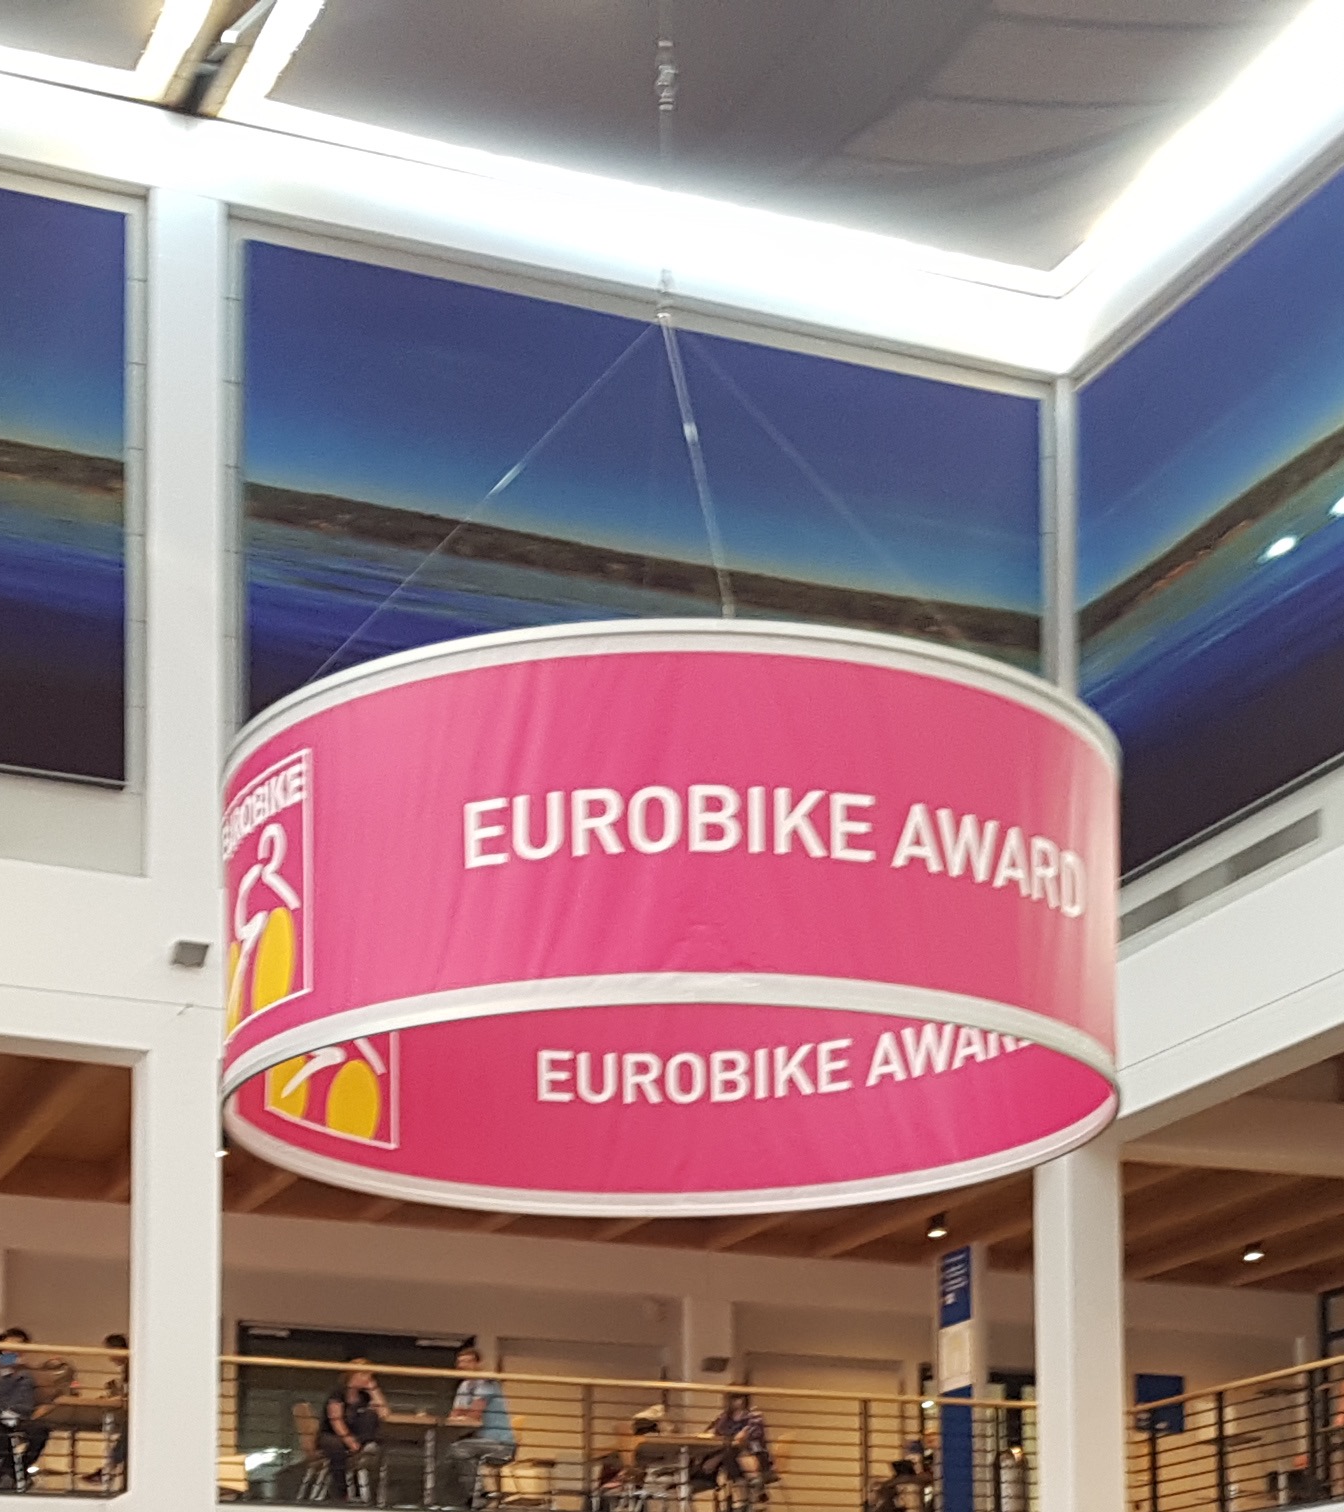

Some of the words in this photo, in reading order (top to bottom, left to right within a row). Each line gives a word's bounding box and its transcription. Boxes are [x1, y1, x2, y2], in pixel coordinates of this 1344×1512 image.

[463, 783, 876, 869] EUROBIKE
[892, 803, 1087, 918] AWARD
[536, 1038, 853, 1105] EUROBIKE
[865, 1021, 1035, 1087] AWA
